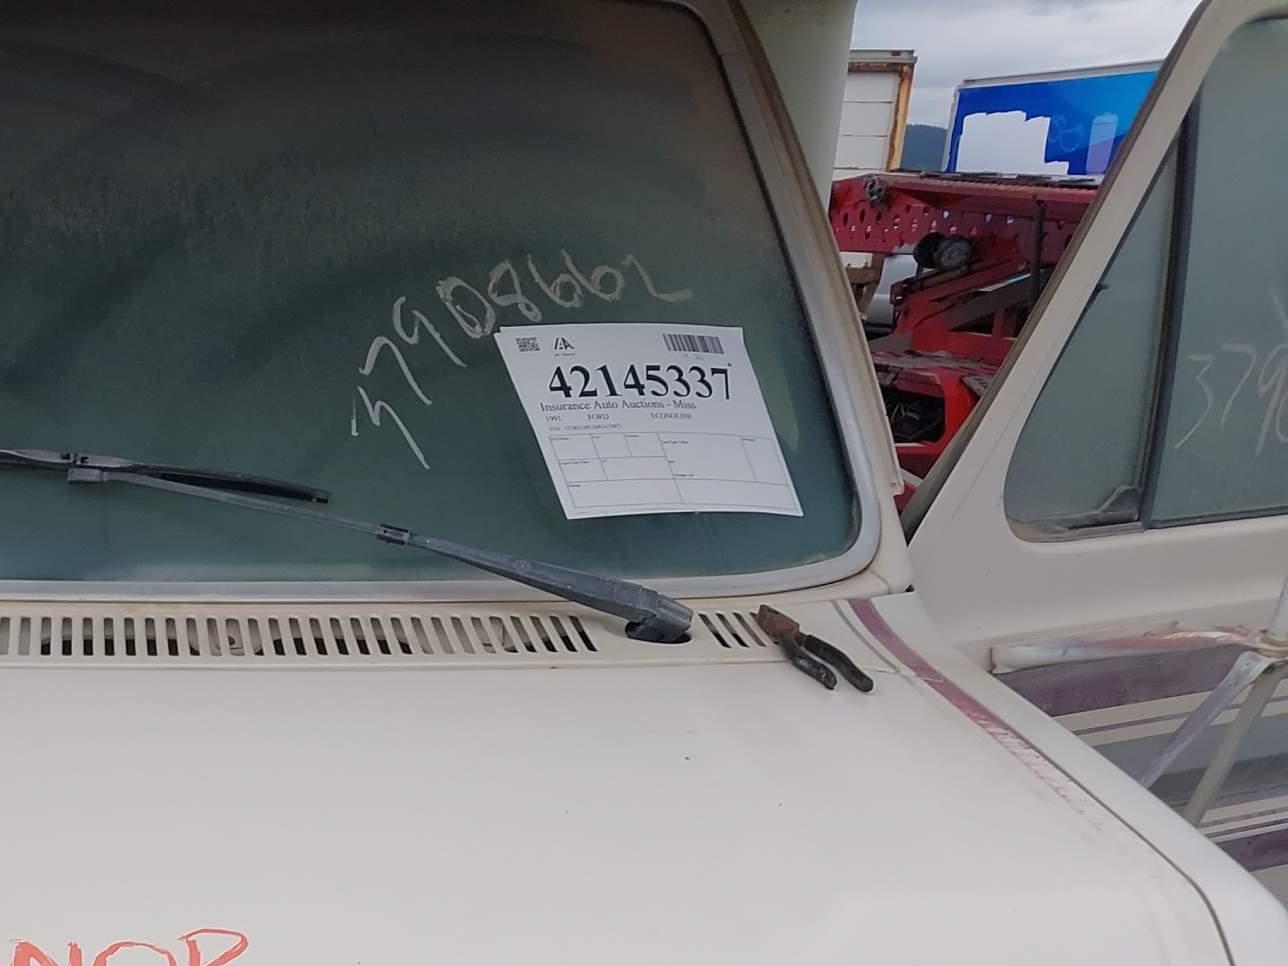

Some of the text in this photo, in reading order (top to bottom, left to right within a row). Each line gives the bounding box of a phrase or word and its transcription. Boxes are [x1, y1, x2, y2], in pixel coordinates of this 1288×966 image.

[548, 363, 731, 400] 42145337
[539, 401, 591, 413] Insurance
[593, 401, 619, 411] Auto
[621, 399, 665, 410] Auctions
